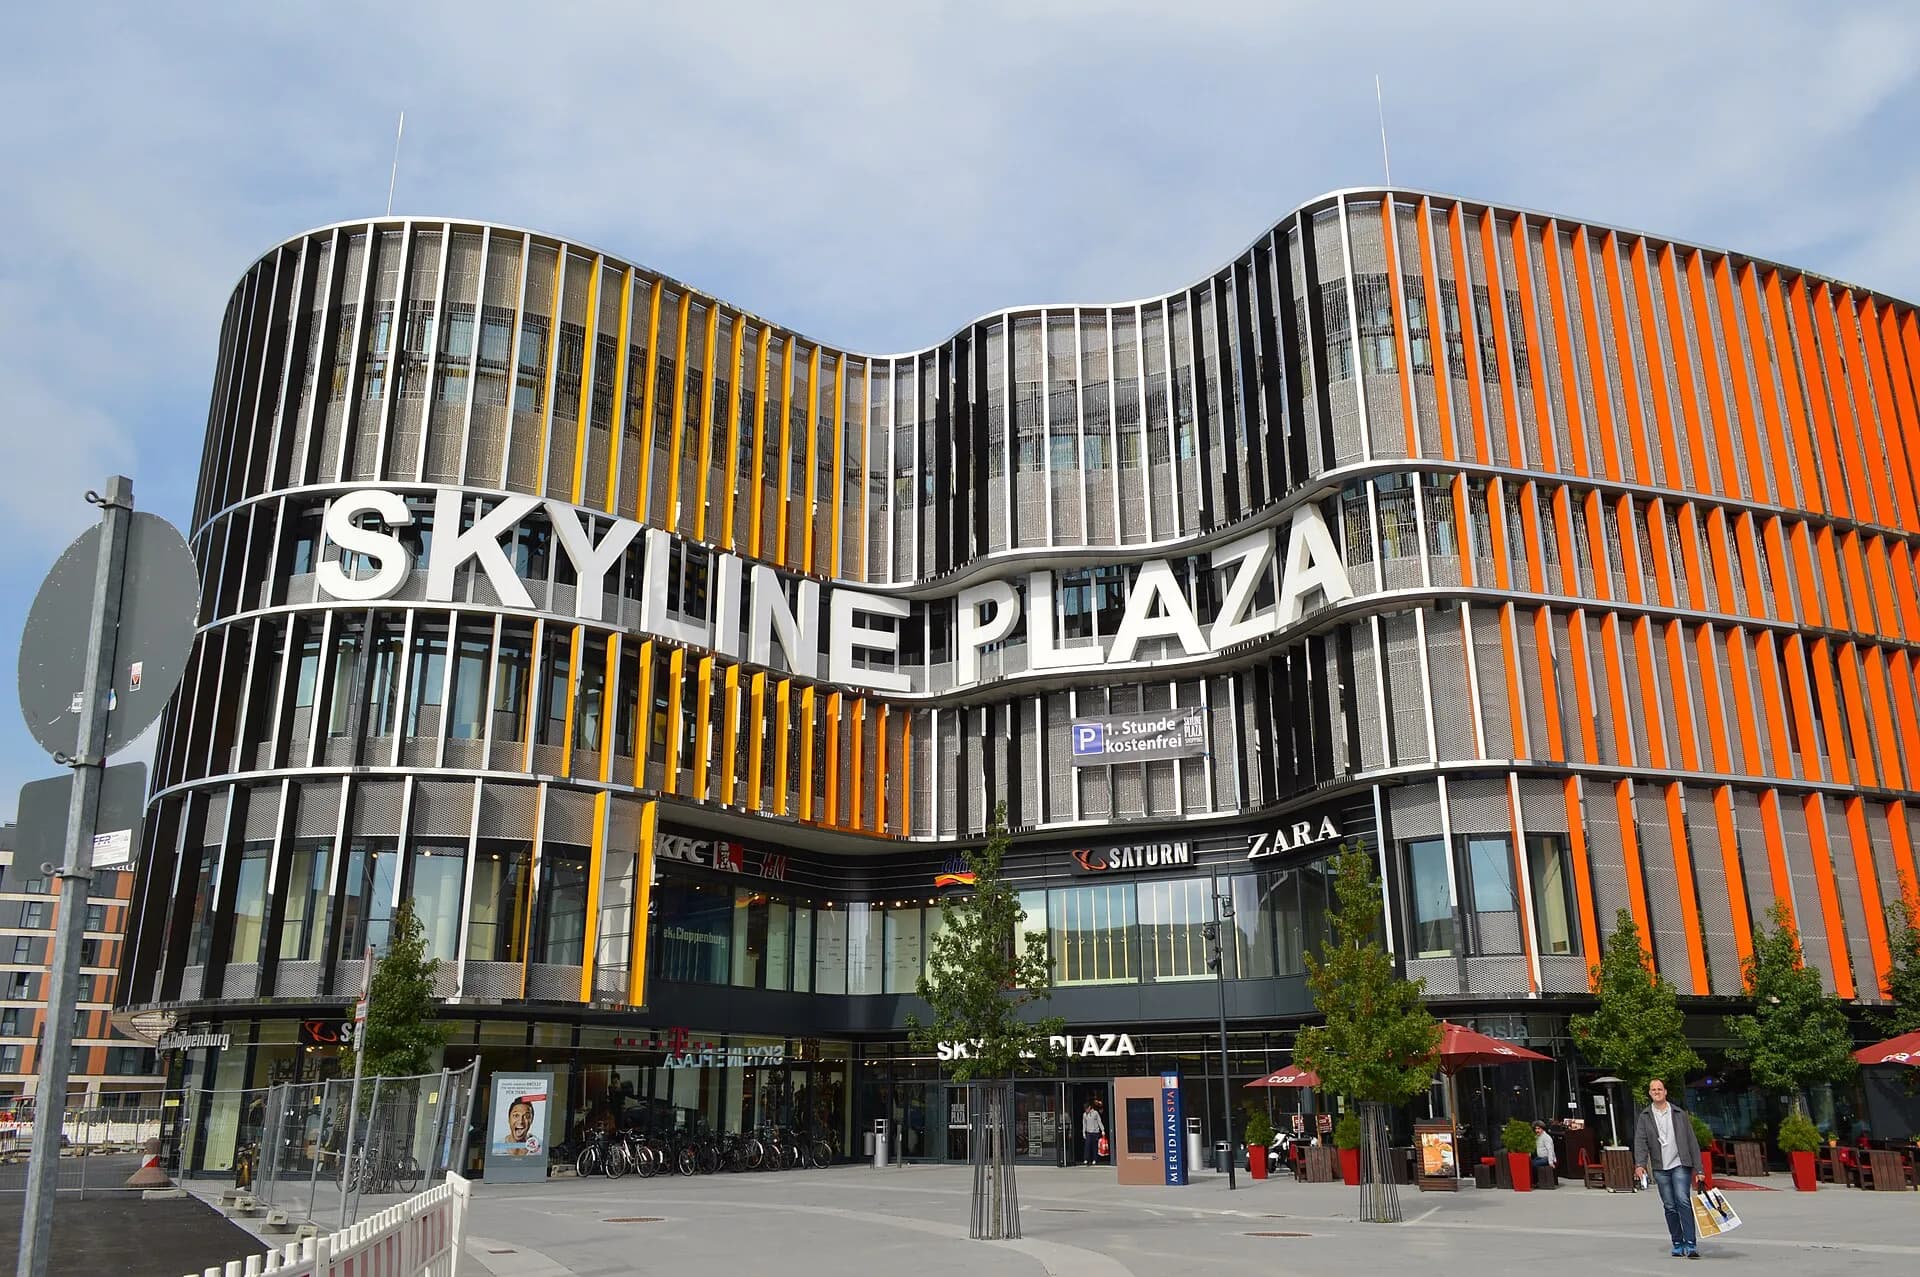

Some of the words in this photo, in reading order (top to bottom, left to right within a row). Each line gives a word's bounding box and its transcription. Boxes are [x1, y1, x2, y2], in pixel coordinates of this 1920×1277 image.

[316, 489, 911, 693] SKYLINE
[957, 502, 1355, 687] PLAZA
[1106, 723, 1119, 736] 1.
[1122, 717, 1176, 735] Stunde
[1184, 725, 1203, 738] PLAZA
[1079, 728, 1096, 750] P
[1105, 733, 1182, 753] kostenfrei
[656, 832, 710, 863] KFC
[1247, 815, 1341, 859] ZARA
[1109, 841, 1189, 869] SATURN
[1050, 1033, 1137, 1057] PLAZA
